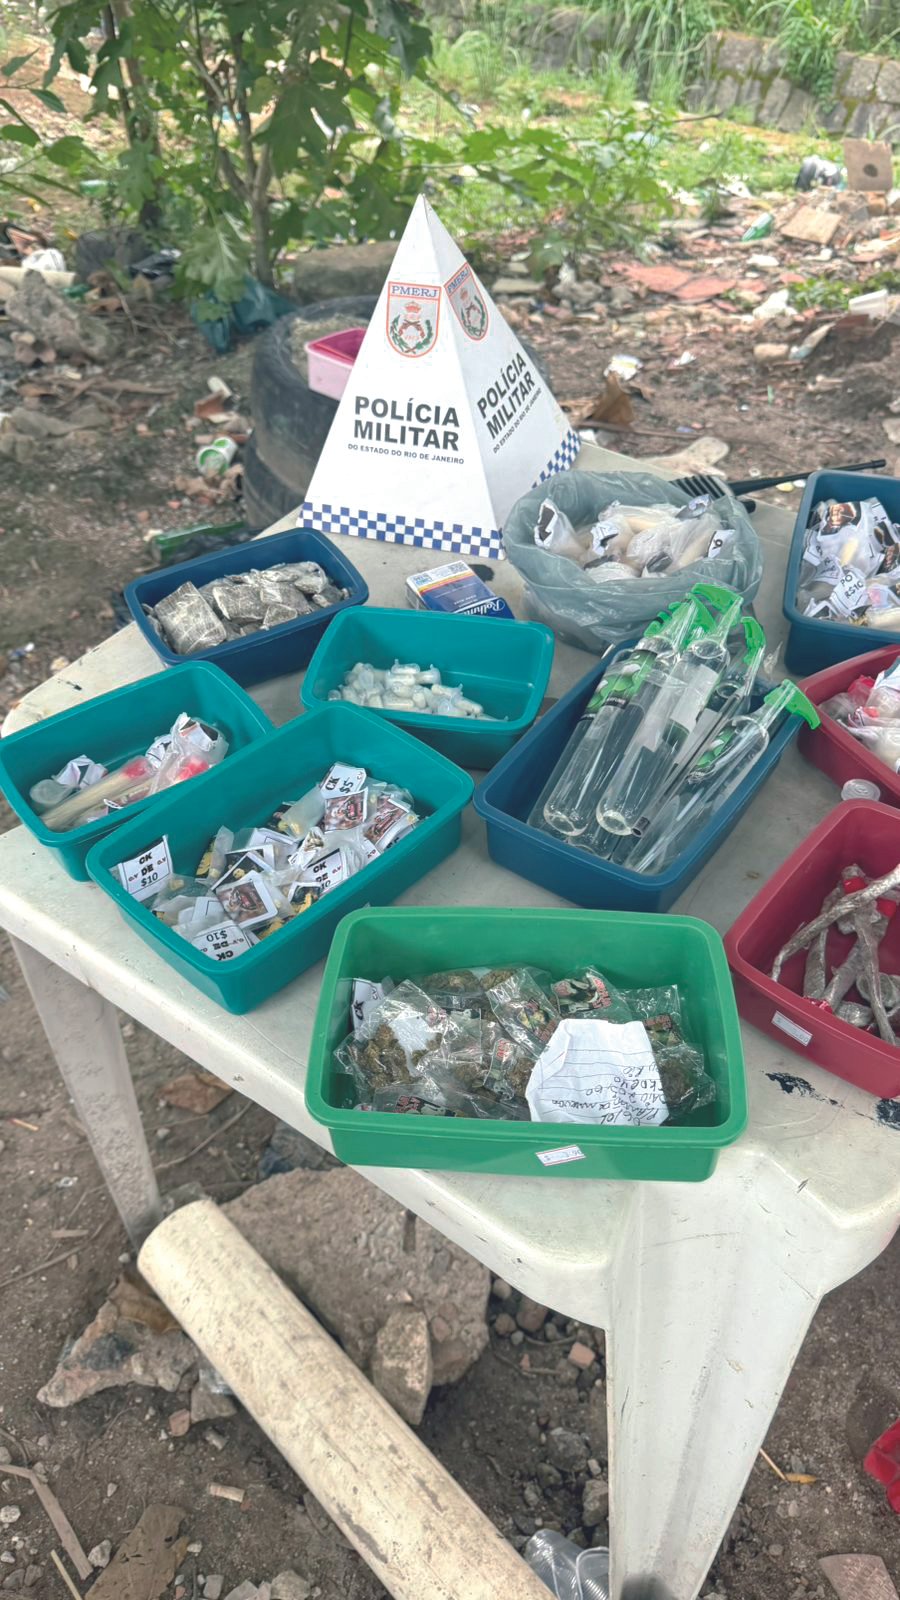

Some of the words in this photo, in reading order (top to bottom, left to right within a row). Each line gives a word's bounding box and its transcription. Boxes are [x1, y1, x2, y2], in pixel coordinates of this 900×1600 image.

[391, 285, 438, 297] PMERJ
[477, 352, 526, 419] POLÍCIA
[355, 396, 460, 428] POLÍCIA
[486, 371, 535, 440] MILITAR
[354, 419, 459, 452] MILITAR
[360, 445, 389, 455] ESTADO
[431, 455, 465, 464] JANEIRO
[325, 776, 341, 791] CK
[340, 777, 354, 793] $5
[139, 852, 152, 865] CK
[141, 864, 154, 876] DE
[313, 861, 327, 873] CK
[141, 872, 158, 887] $10
[206, 930, 228, 942] $10
[212, 941, 229, 951] DE
[216, 950, 234, 961] CK
